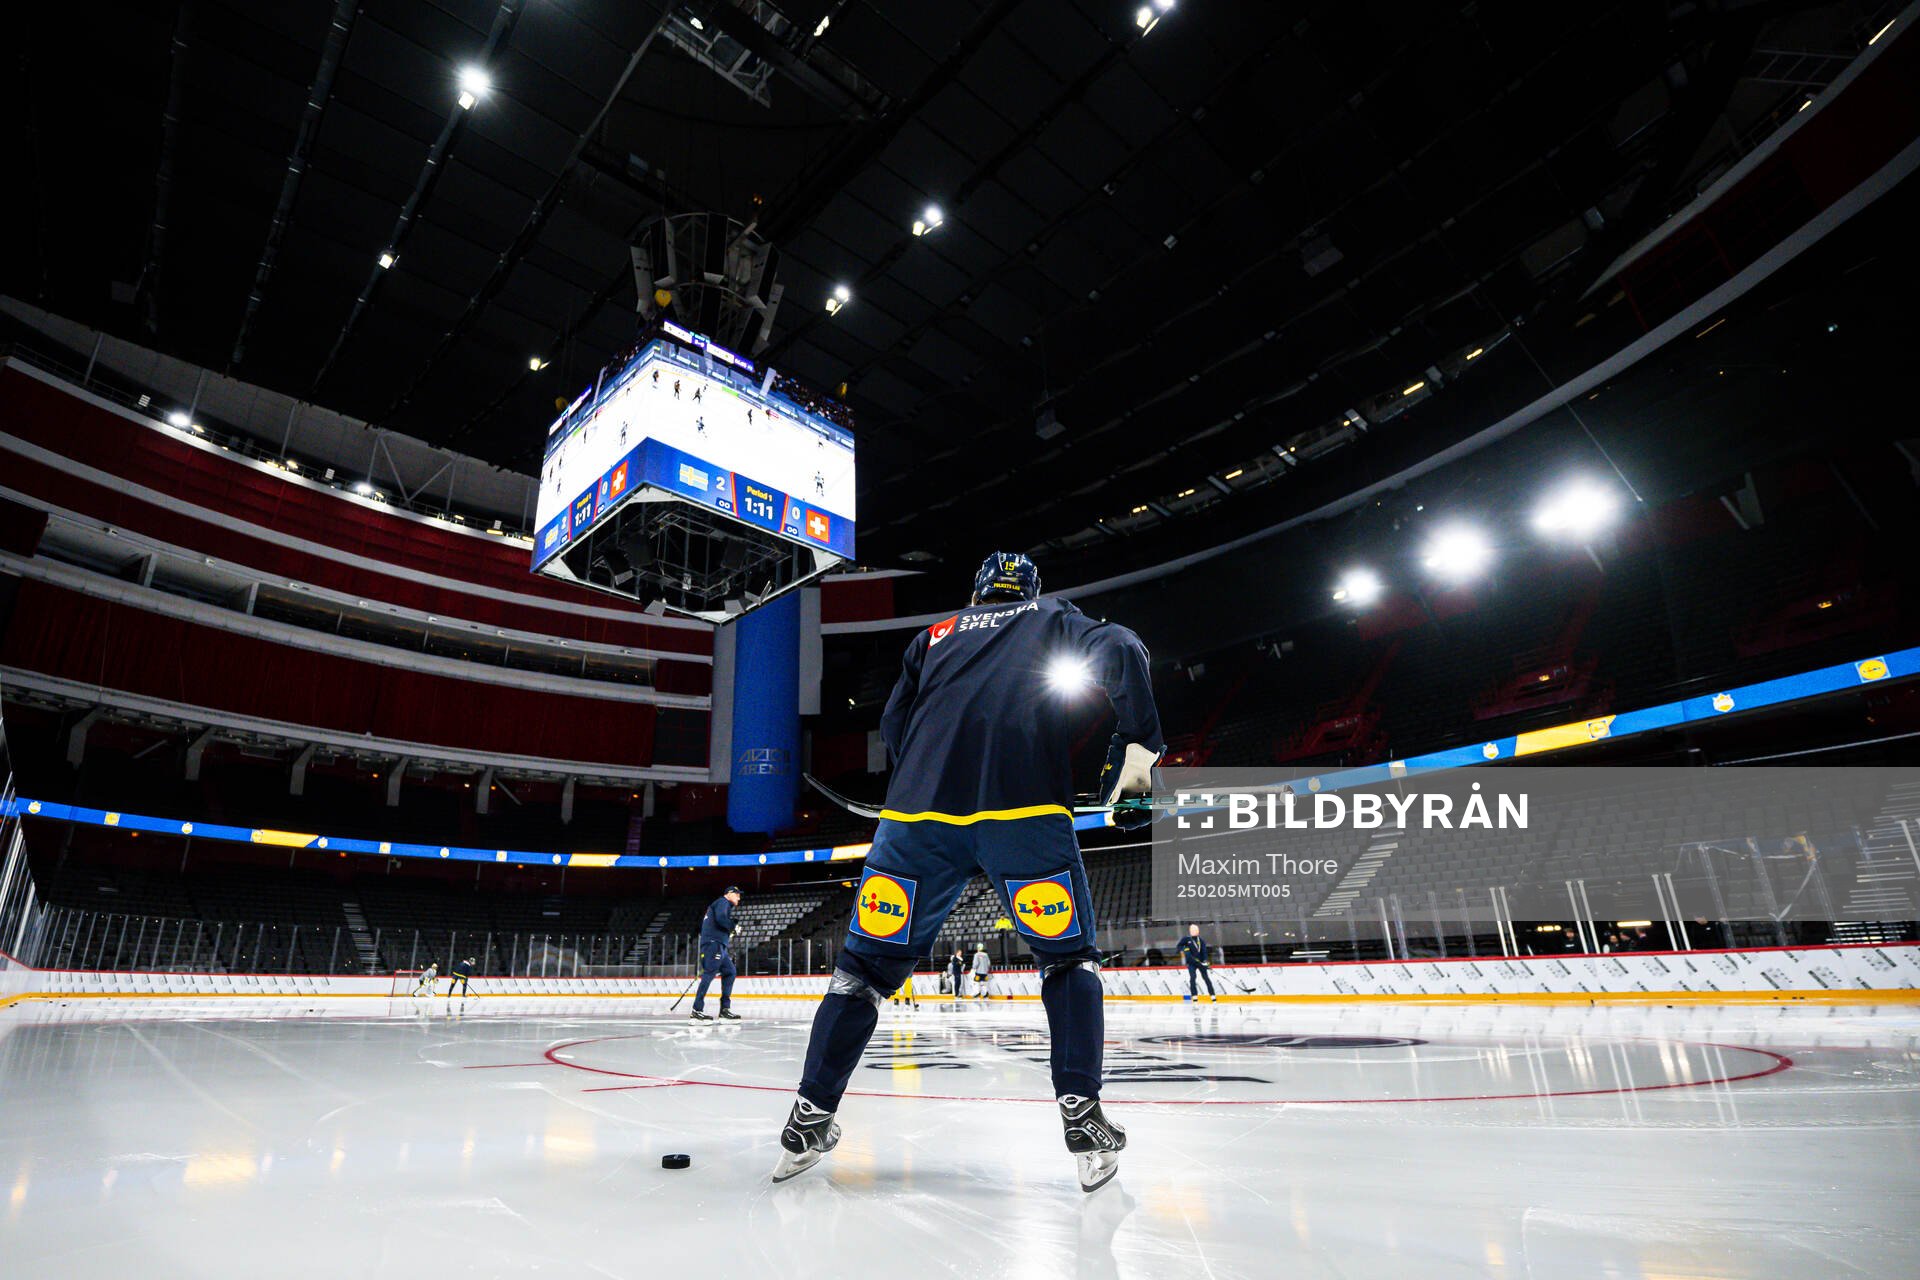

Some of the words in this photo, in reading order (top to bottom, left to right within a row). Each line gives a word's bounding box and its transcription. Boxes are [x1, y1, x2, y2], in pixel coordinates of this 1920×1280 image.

[602, 481, 608, 495] 0
[715, 476, 725, 491] 2
[746, 486, 768, 500] Period
[575, 503, 591, 527] 1:11
[744, 497, 773, 520] 1:11
[791, 506, 801, 520] 0
[1004, 561, 1015, 571] 19
[961, 601, 1039, 624] SVENSKA
[958, 619, 1000, 632] SPEL
[1086, 1122, 1111, 1147] CCM
